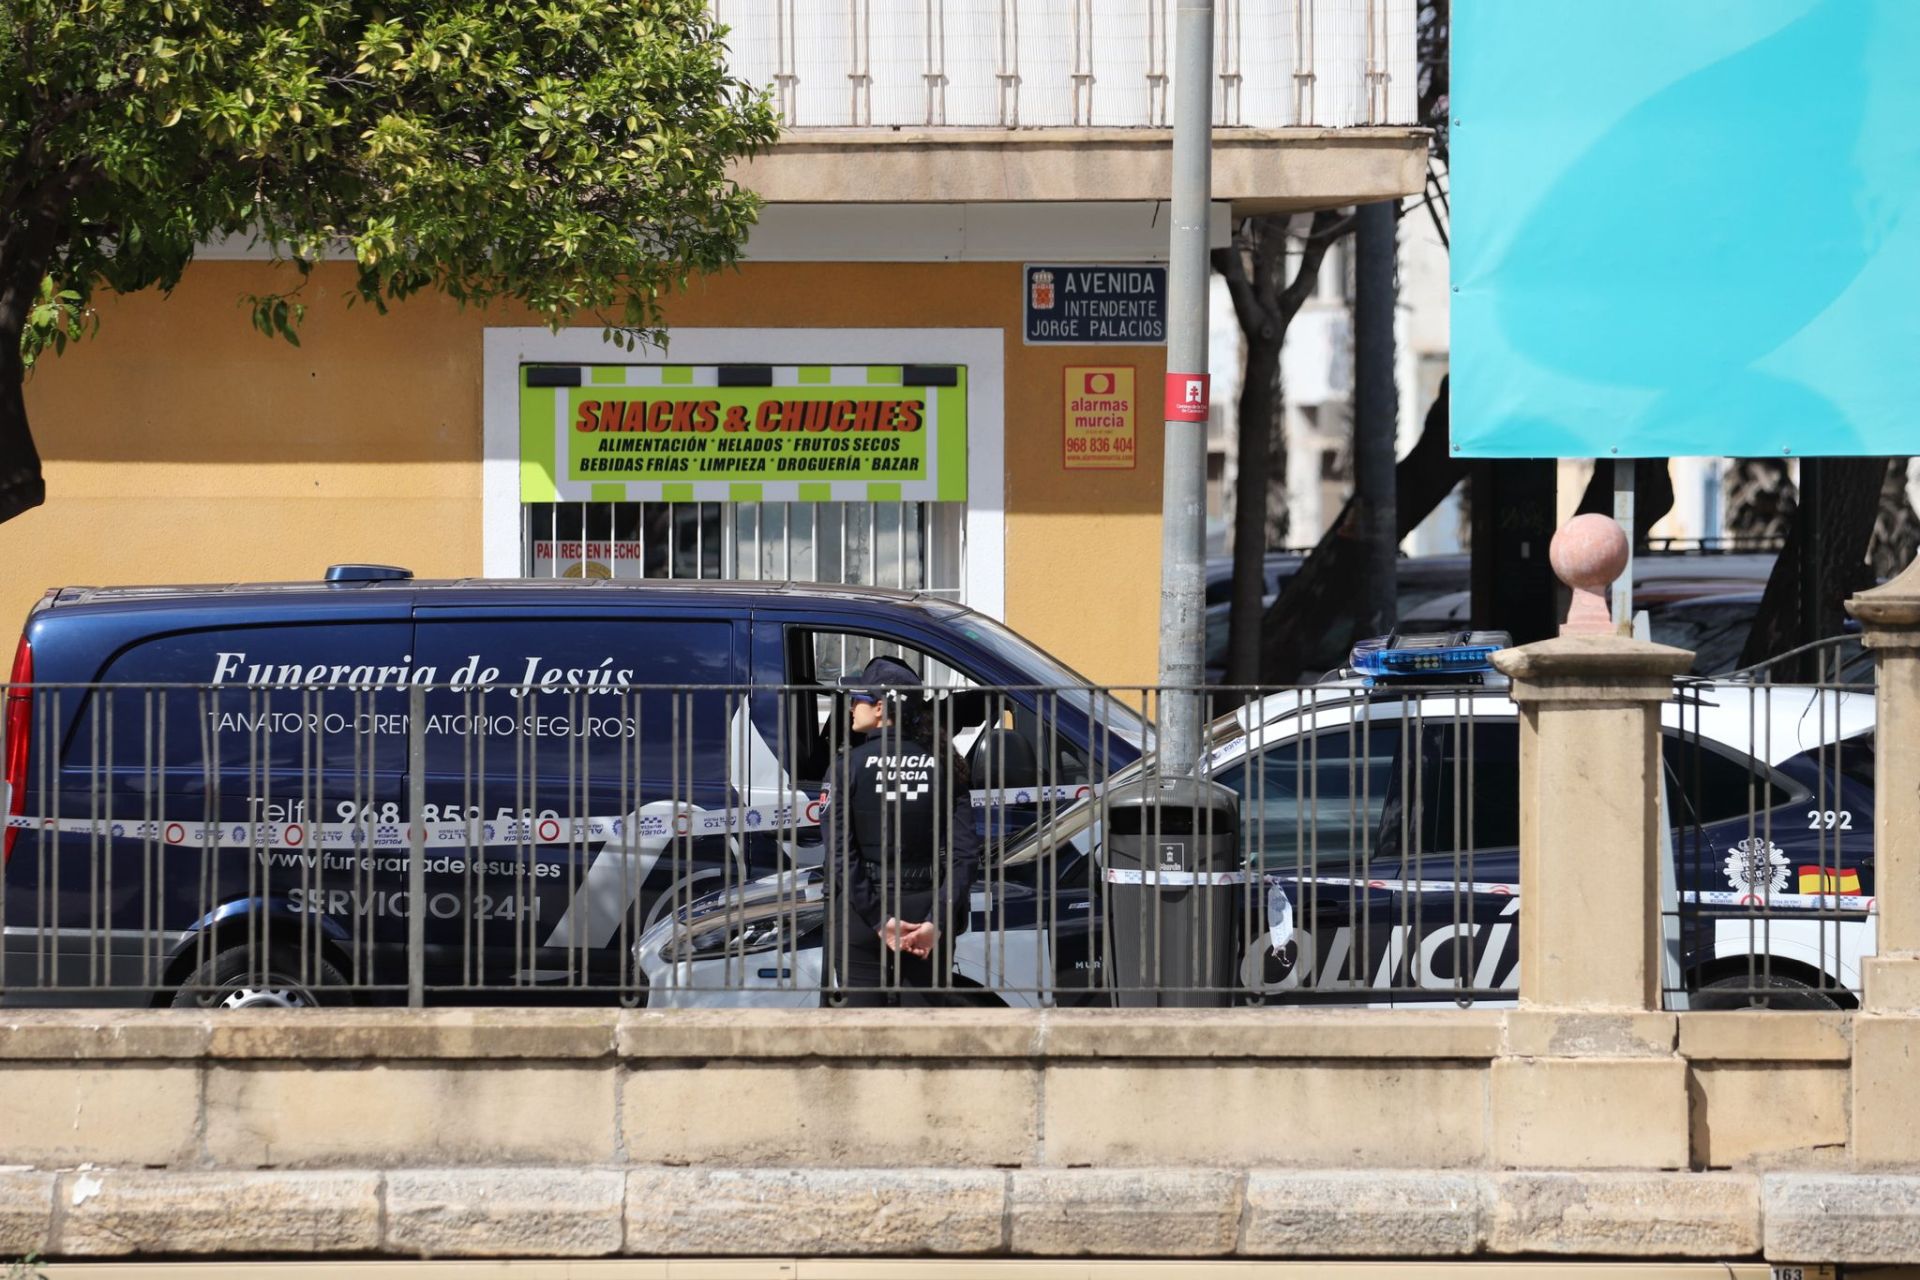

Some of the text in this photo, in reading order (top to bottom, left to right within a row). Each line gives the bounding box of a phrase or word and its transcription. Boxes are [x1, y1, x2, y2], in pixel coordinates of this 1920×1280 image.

[1064, 272, 1155, 294] AVENIDA
[1064, 300, 1158, 317] INTENDENTE
[1031, 320, 1162, 337] JORGE PALACIOS
[1071, 397, 1129, 412] alarmas
[576, 400, 925, 433] SNACKS & CHUCHES
[1075, 413, 1124, 428] murcia
[598, 436, 901, 452] ALIMENTACIÓN HELADOS FRUTOS SECOS
[1066, 437, 1133, 453] 968 836 404
[580, 454, 920, 472] BEBIDAS FRÍAS LIMPIEZA DROGUERÍA BAZAR
[561, 543, 601, 560] RECEN
[209, 652, 634, 697] Funeraria de Jesús
[208, 711, 636, 738] TANATORO-CREATORIO-SEGUROS
[865, 754, 936, 768] POLICÍA
[876, 770, 928, 780] MURCIA
[336, 800, 401, 823] 968
[1807, 810, 1853, 830] 292
[286, 888, 541, 921] SERVICO 24H
[1240, 897, 1520, 995] OLICÍ
